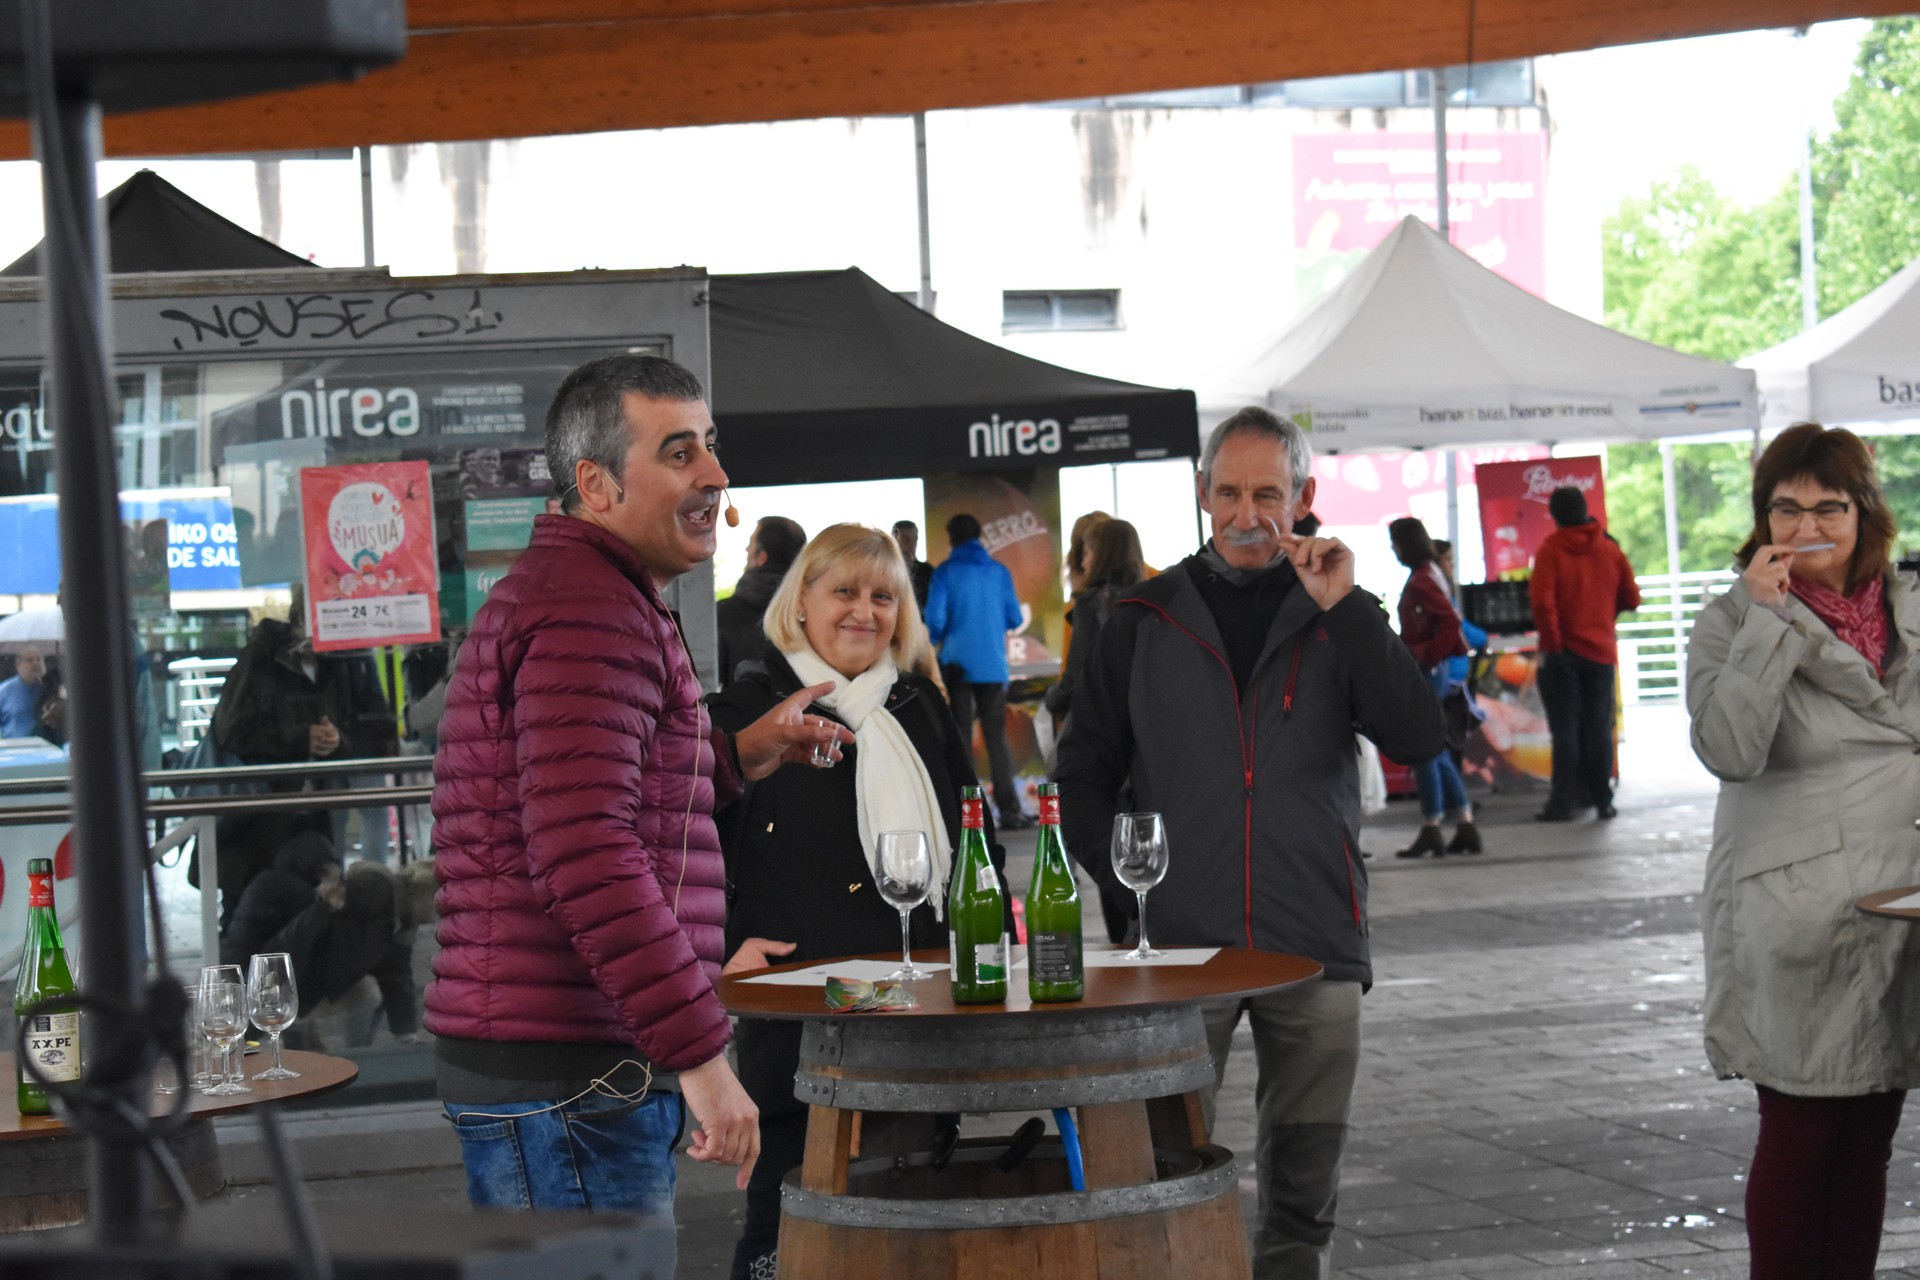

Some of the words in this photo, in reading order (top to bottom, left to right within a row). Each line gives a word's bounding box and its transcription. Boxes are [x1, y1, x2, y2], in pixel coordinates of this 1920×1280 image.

[281, 378, 420, 438] nirea
[968, 412, 1062, 458] nirea
[343, 519, 399, 551] MUSUA
[167, 547, 197, 568] DE
[352, 604, 367, 619] 24
[32, 1037, 72, 1049] AXPE
